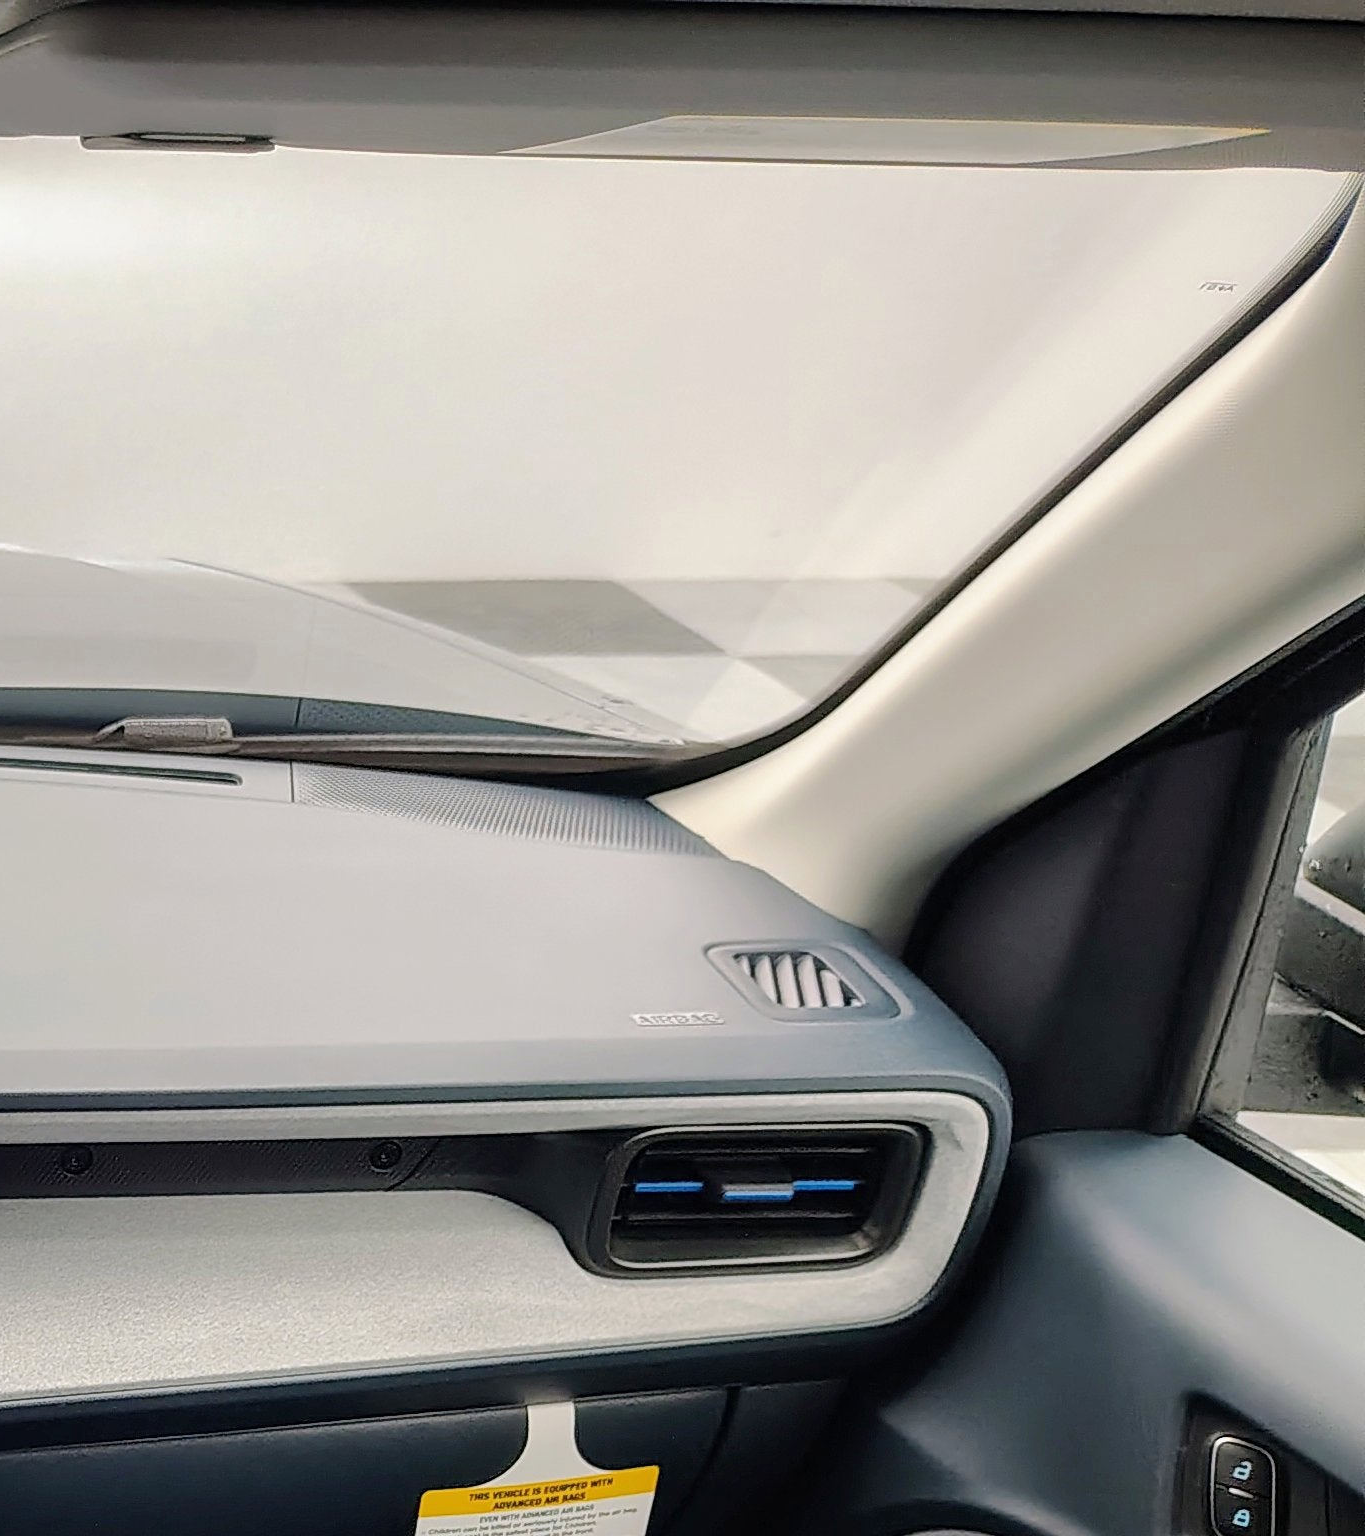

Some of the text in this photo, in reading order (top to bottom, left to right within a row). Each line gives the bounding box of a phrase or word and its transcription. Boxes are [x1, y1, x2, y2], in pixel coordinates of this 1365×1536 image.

[469, 1478, 613, 1502] THIS VEHICLE IS EQUIPPED WITH
[493, 1492, 586, 1510] ADVANCED AIR BAGS
[479, 1504, 595, 1524] EVEN WITH ADVANCED AIR BAGS
[428, 1526, 461, 1535] Children
